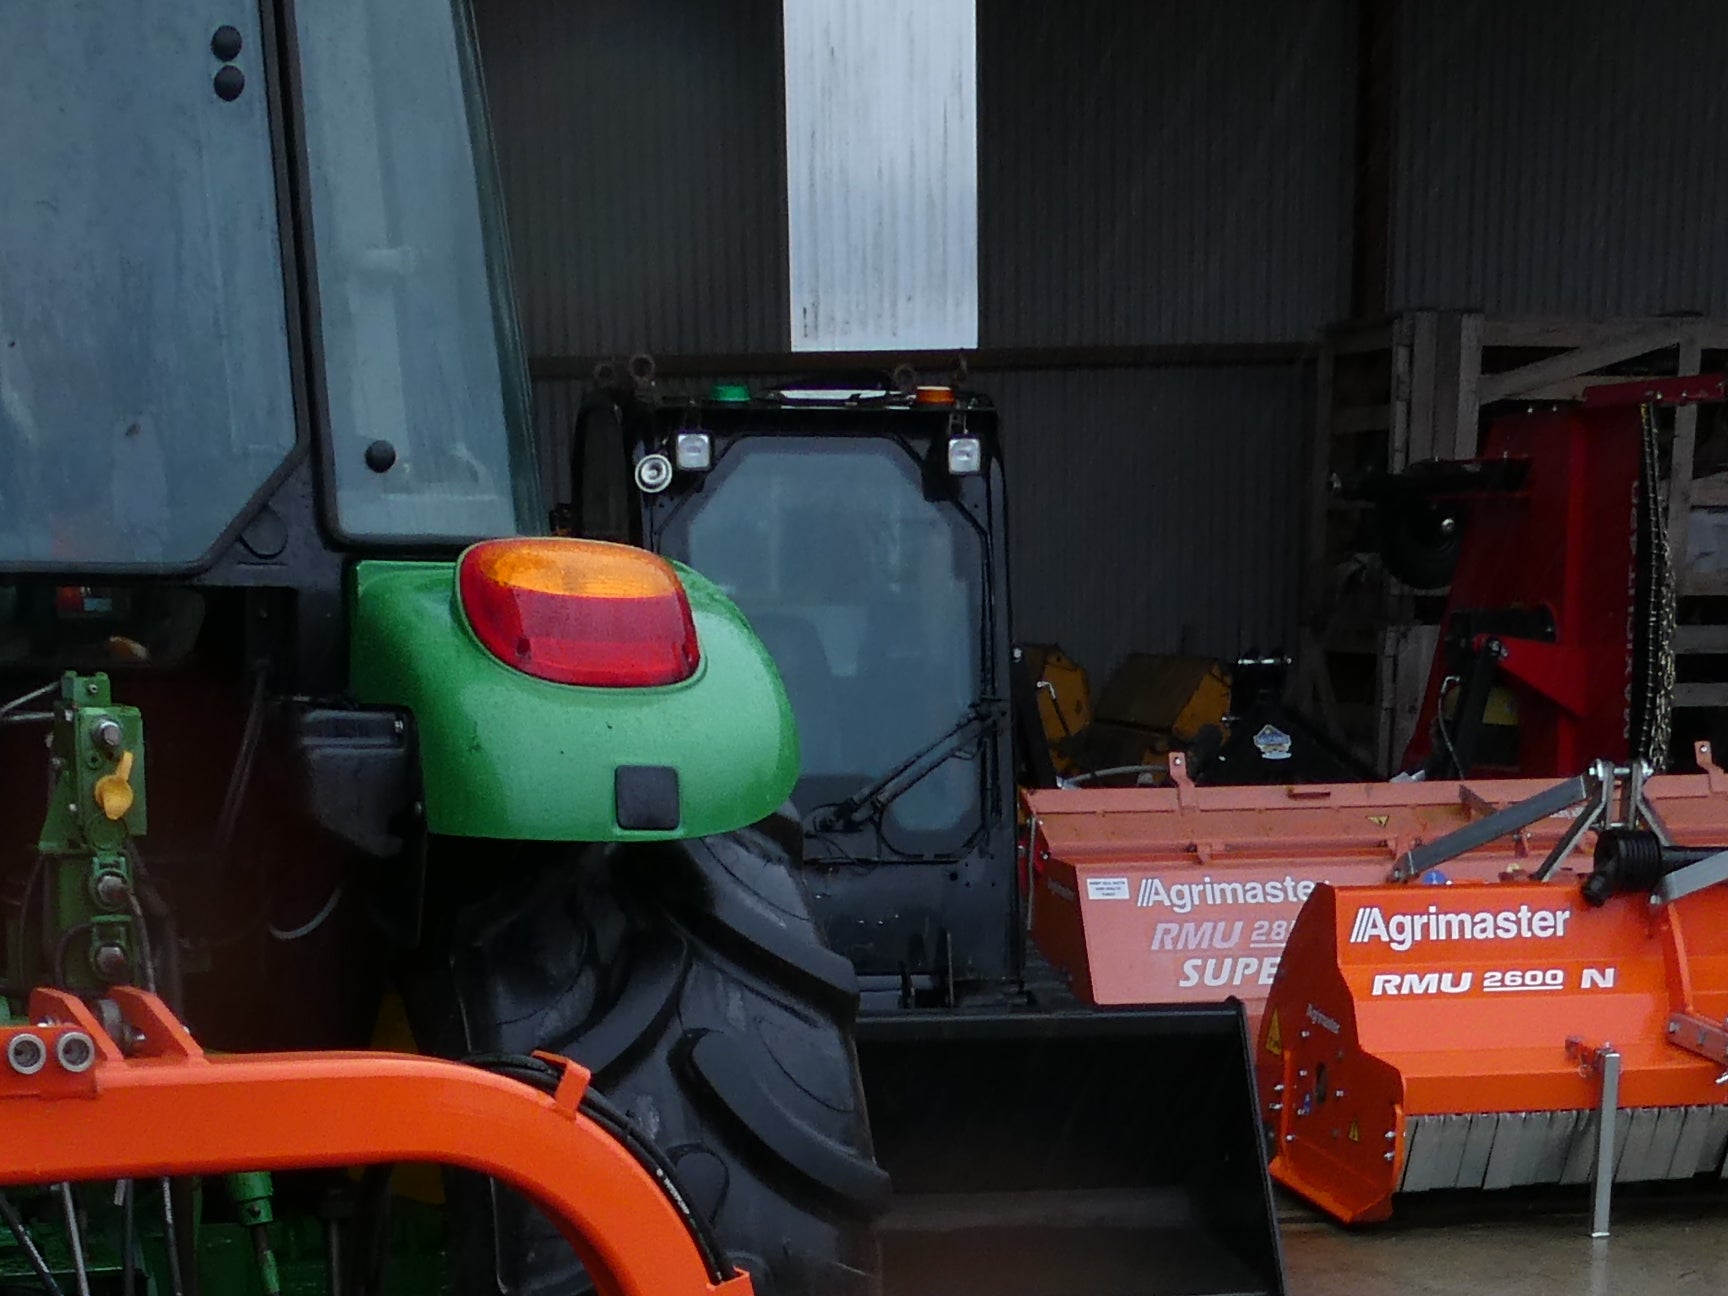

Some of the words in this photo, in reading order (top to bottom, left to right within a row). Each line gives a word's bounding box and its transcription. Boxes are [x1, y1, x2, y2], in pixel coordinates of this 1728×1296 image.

[1137, 875, 1330, 913] Agrimaste
[1151, 921, 1244, 951] RMU
[1349, 904, 1571, 952] Agrimaster
[1179, 957, 1281, 988] SUPE
[1372, 972, 1473, 997] RMU
[1482, 969, 1564, 991] 2600
[1580, 968, 1615, 990] N
